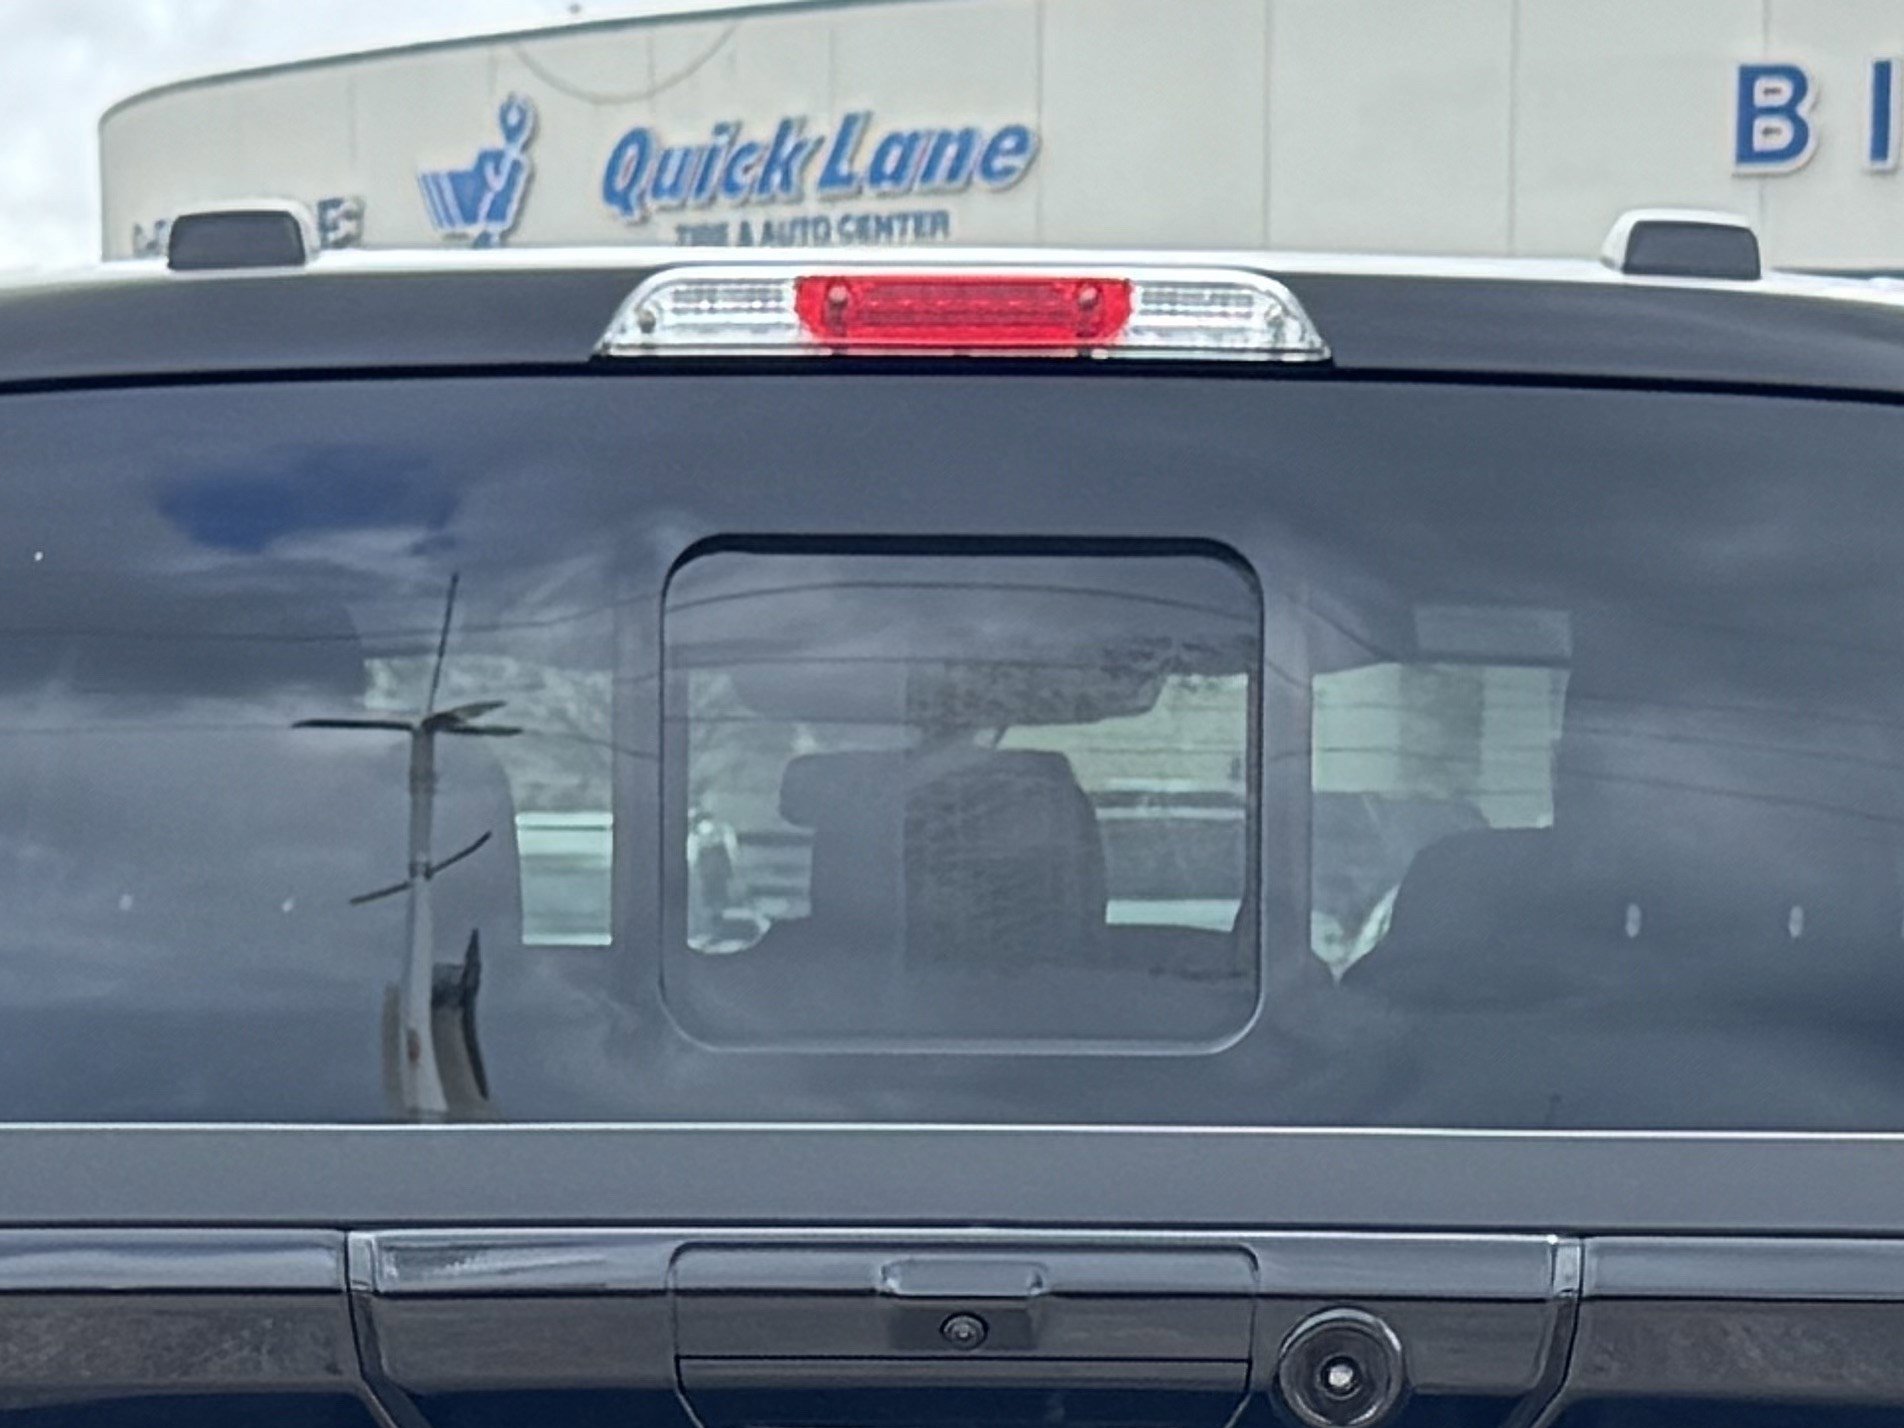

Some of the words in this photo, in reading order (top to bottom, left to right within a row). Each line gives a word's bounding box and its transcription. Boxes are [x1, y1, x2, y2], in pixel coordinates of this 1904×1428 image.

[602, 113, 823, 222] Quick
[818, 111, 1036, 196] Lane
[760, 214, 831, 246] AUTO
[837, 209, 951, 243] CENTER
